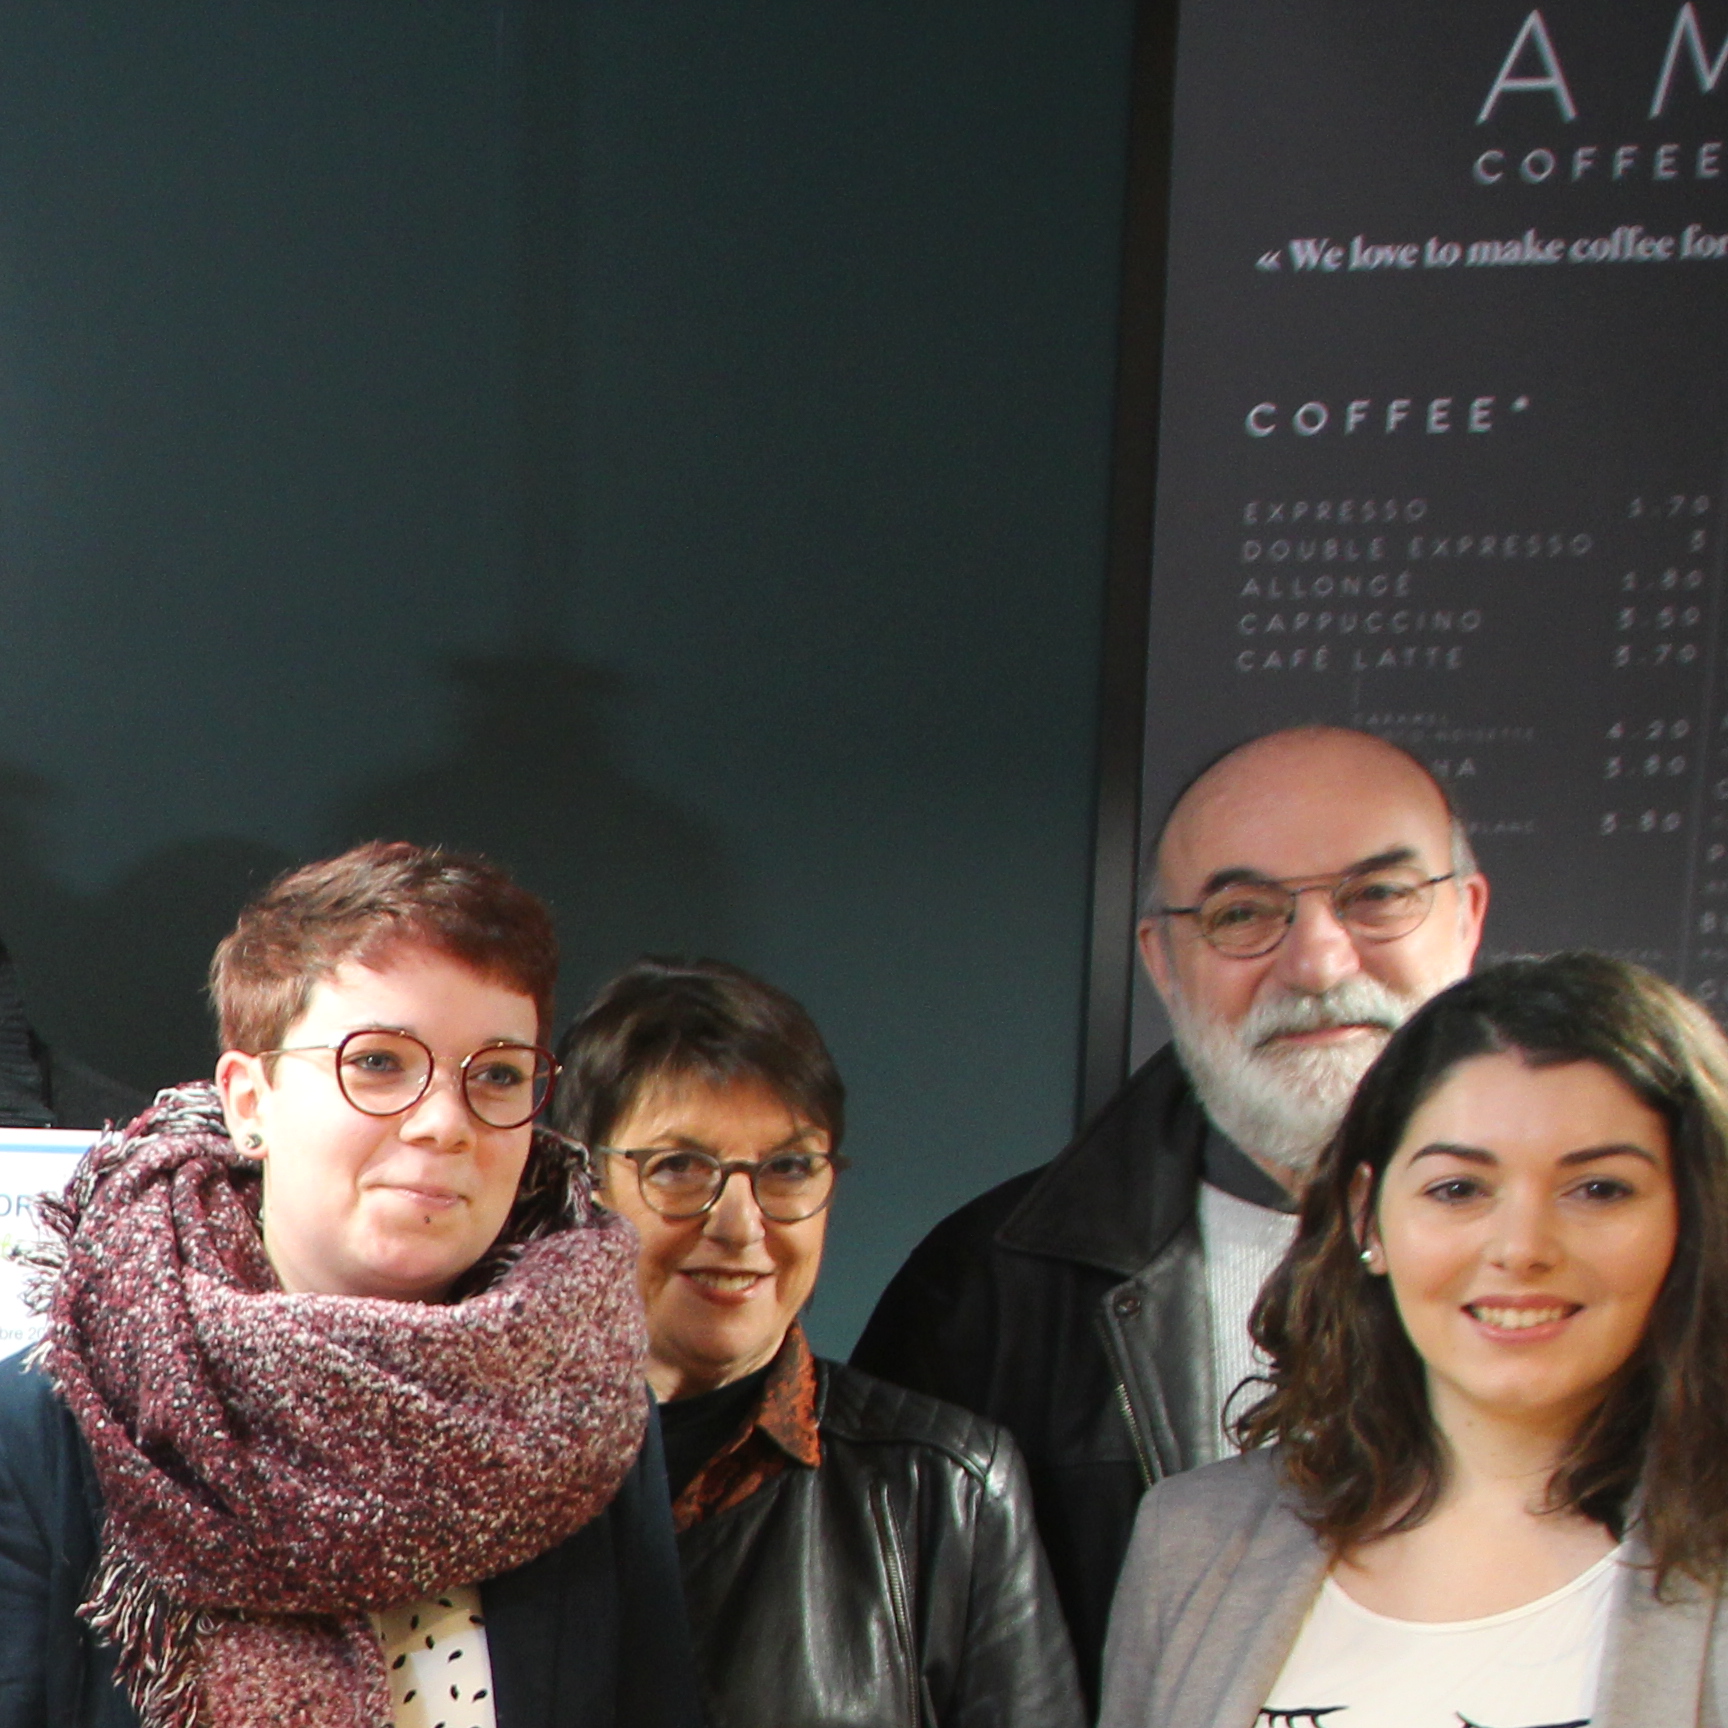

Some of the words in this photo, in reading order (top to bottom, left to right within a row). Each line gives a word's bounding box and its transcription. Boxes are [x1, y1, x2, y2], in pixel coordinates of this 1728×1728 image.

[1472, 142, 1723, 185] COFFEE
[1348, 233, 1418, 272] love
[1424, 236, 1461, 269] to
[1464, 228, 1563, 267] make
[1568, 225, 1675, 265] coffee
[1243, 498, 1428, 525] EXPRESSO
[1241, 536, 1386, 563] DOUBLE
[1407, 532, 1594, 560] EXPRESSO
[1238, 609, 1482, 636] CAPPUCCINO
[1235, 645, 1329, 672] CAFÉ
[1353, 646, 1463, 670] LATTE
